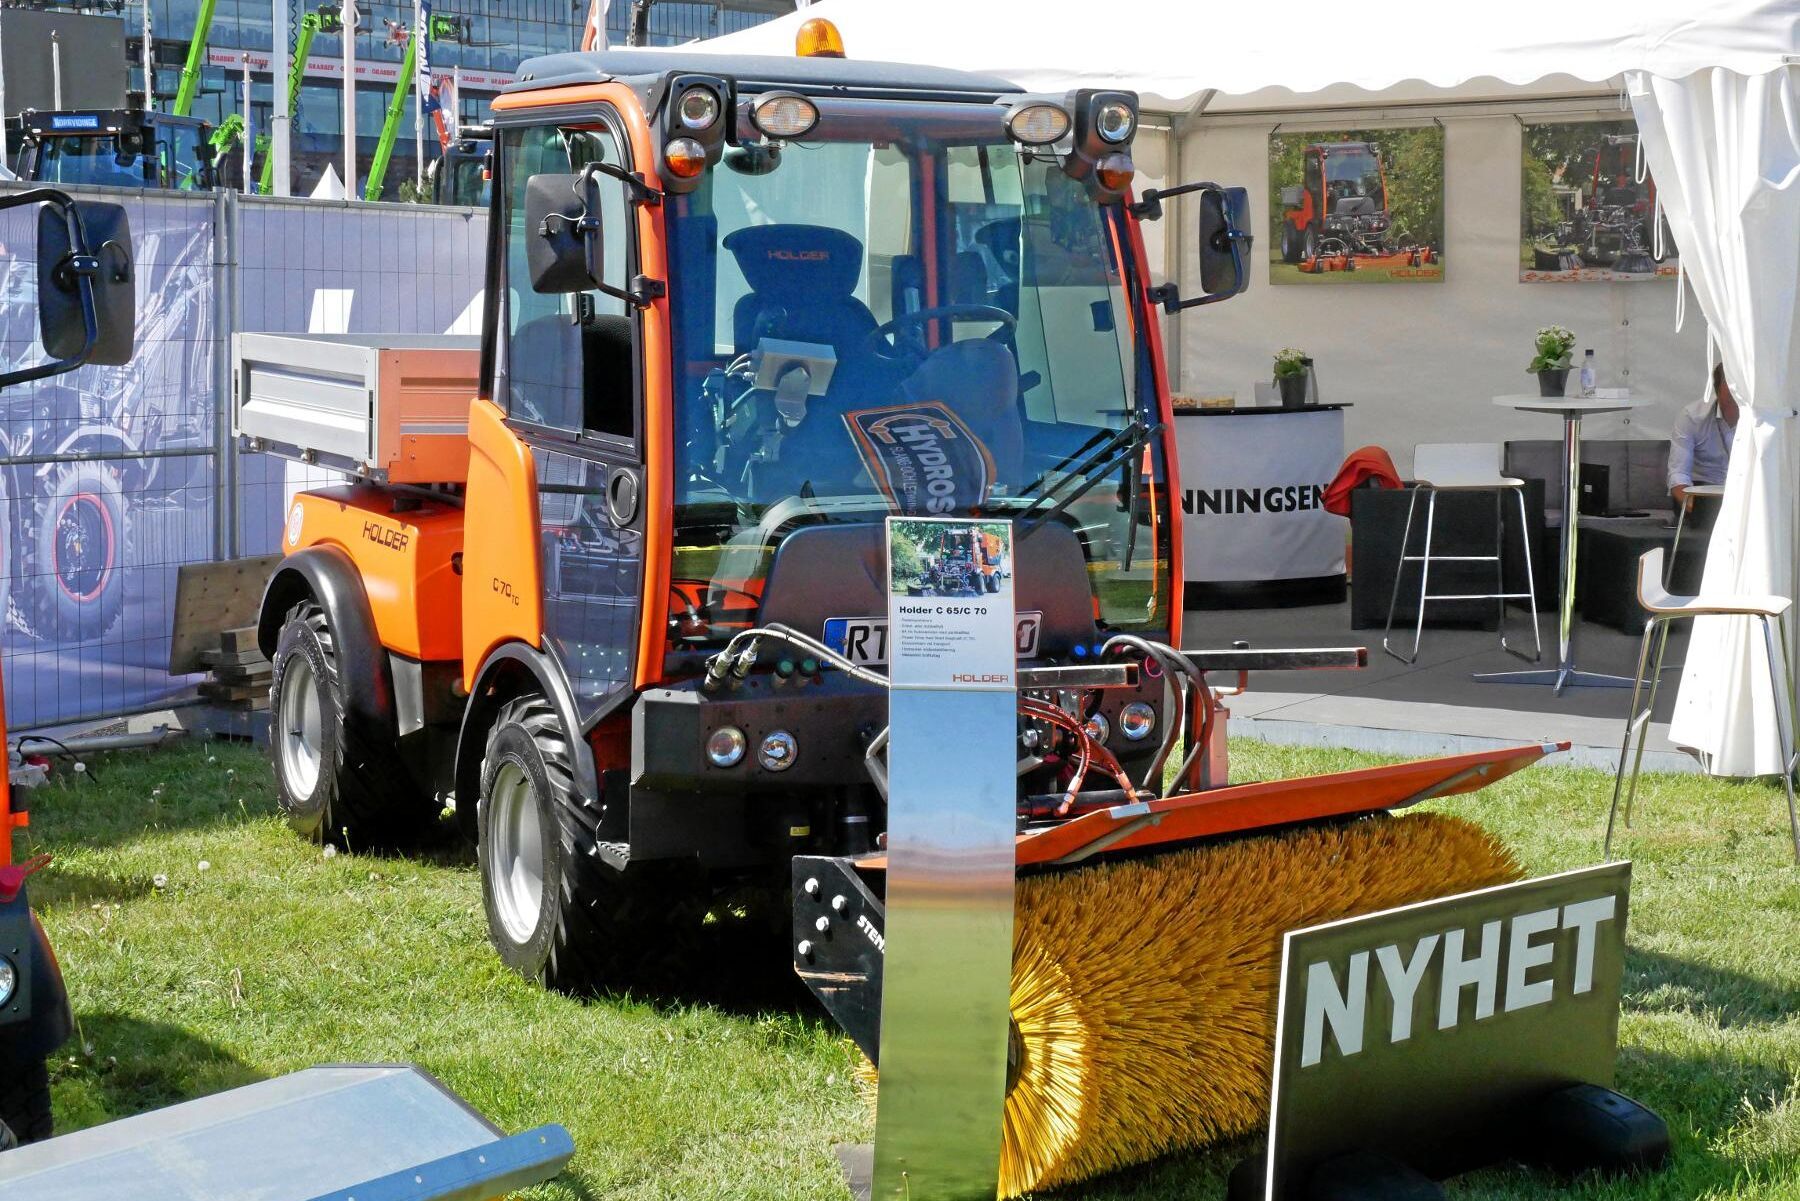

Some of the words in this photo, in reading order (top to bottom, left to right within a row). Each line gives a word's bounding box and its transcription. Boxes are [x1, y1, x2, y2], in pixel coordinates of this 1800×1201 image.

[767, 249, 830, 260] HOLDER
[1654, 266, 1687, 276] HOL
[362, 520, 409, 553] HOLDER
[899, 606, 932, 614] Holder
[936, 606, 943, 614] C
[946, 607, 971, 615] 65/C
[974, 607, 987, 615] 70
[952, 673, 1009, 683] HOLDER
[857, 914, 886, 955] STEN
[1300, 894, 1617, 1069] NYHET
